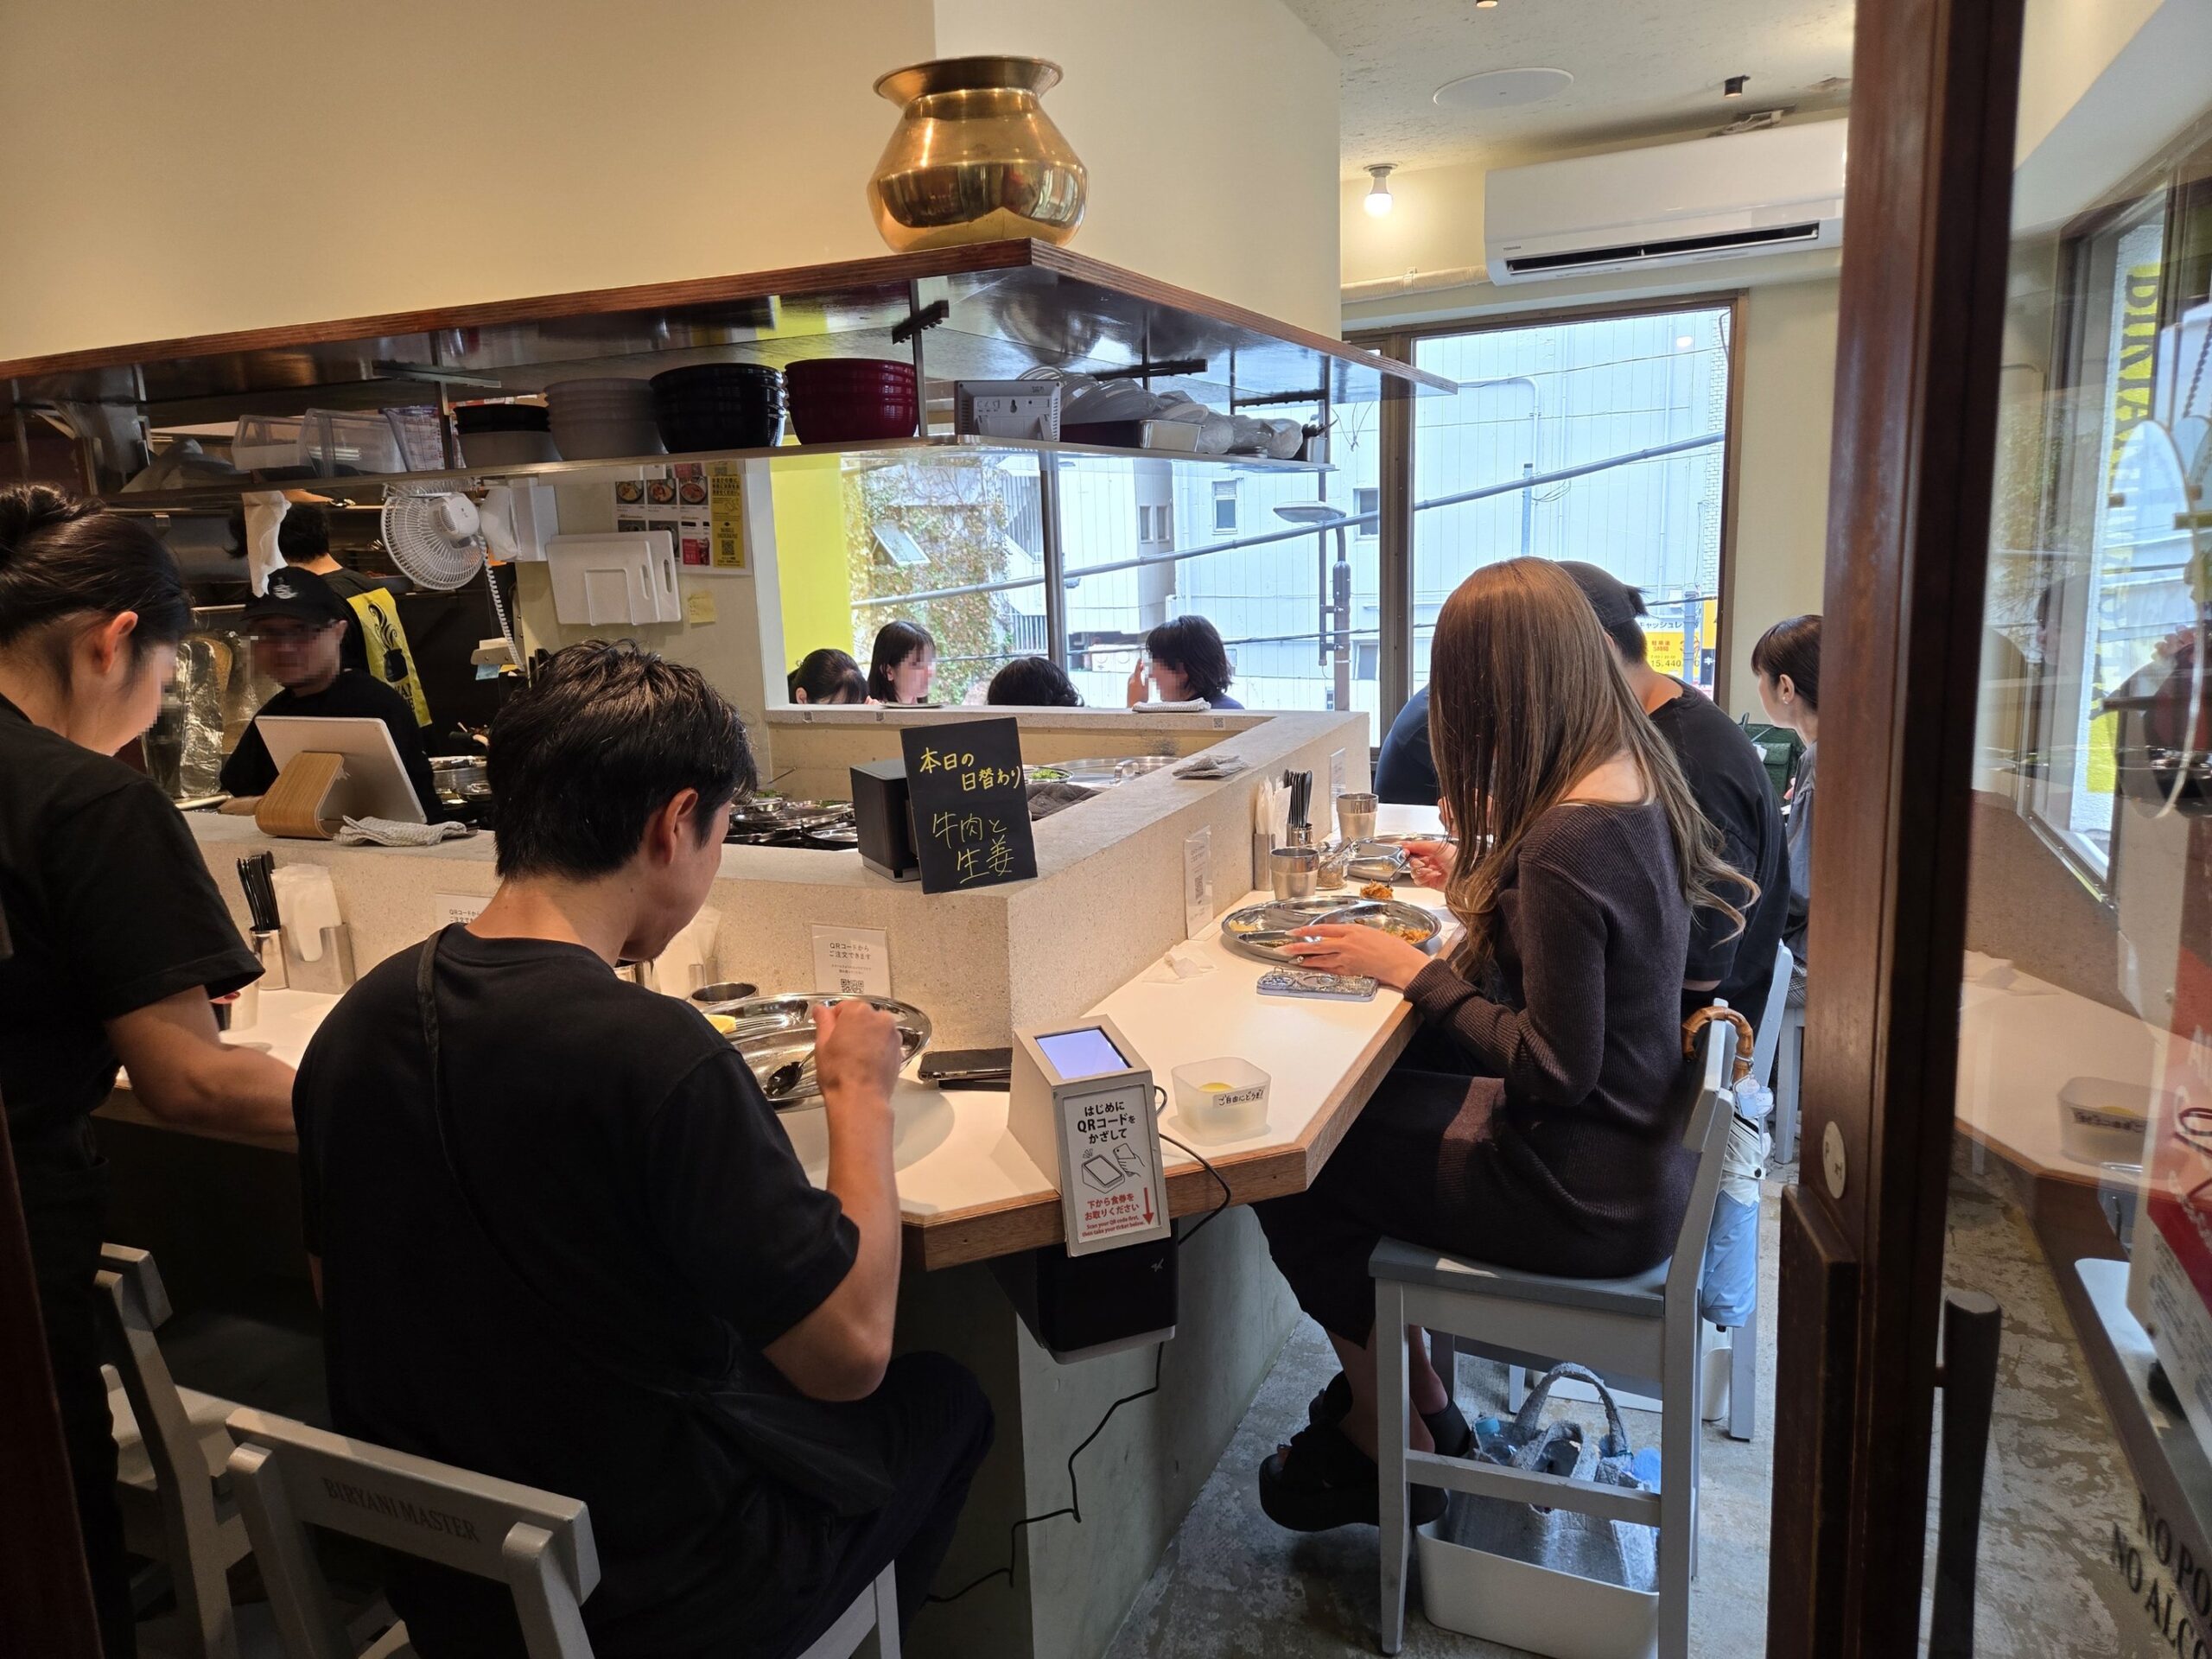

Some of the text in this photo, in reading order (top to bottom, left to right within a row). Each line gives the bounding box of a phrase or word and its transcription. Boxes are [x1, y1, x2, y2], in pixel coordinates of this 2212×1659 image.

[919, 747, 975, 774] 本日の
[962, 766, 1021, 791] 日替わり
[932, 811, 1007, 849] 牛肉と
[957, 834, 1014, 885] 生姜
[830, 942, 870, 952] QRコードから
[830, 950, 872, 960] ご注文できます
[1084, 1102, 1125, 1117] はじめに
[1077, 1112, 1136, 1133] QRコードを
[1089, 1128, 1128, 1145] かざして
[1084, 1204, 1140, 1221] お取りください
[1087, 1192, 1135, 1210] 下から食券を
[321, 1477, 481, 1543] BIRYANI MASTER
[2139, 1493, 2172, 1566] NO
[2112, 1521, 2143, 1594] NO
